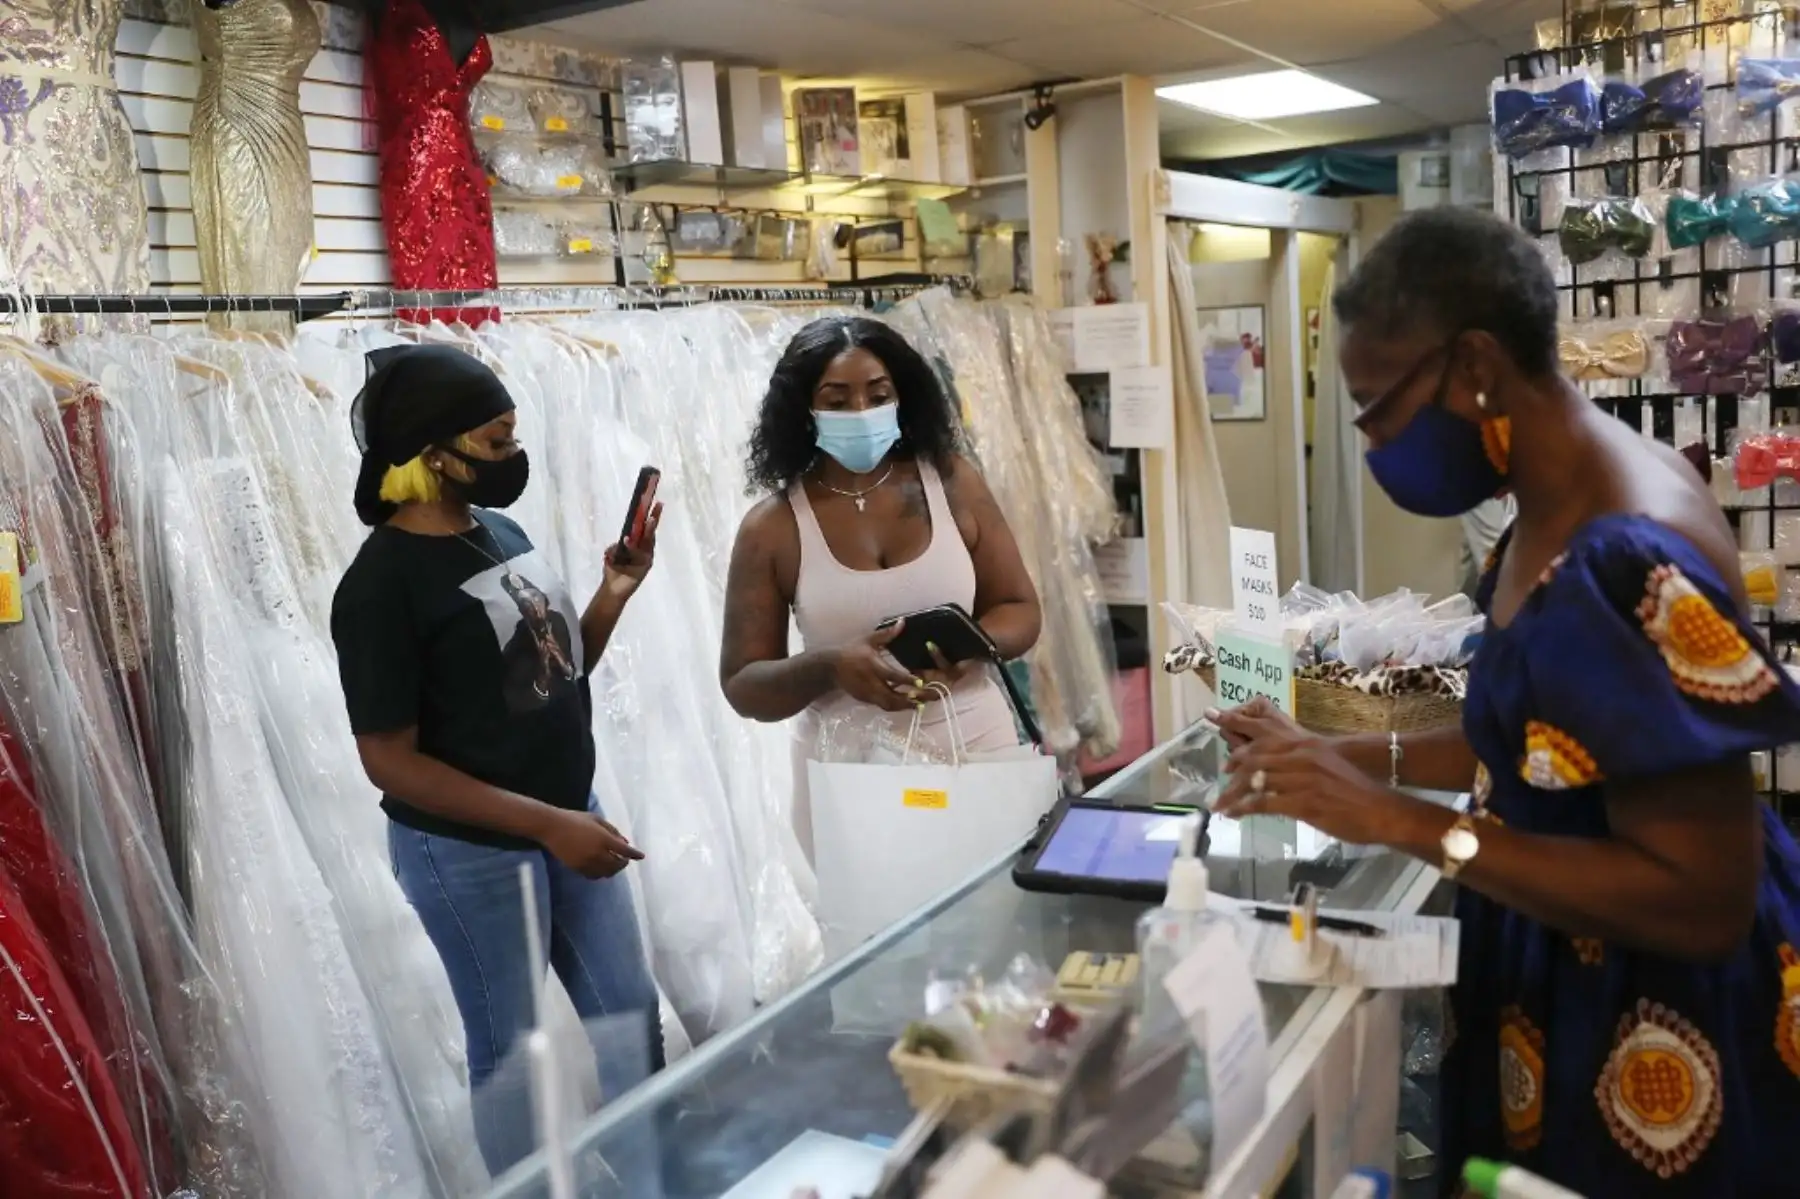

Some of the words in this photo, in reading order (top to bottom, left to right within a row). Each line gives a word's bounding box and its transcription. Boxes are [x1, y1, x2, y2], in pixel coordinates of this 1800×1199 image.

[1244, 552, 1268, 570] FACE
[1241, 576, 1273, 595] MASKS
[1217, 646, 1250, 673] Cash
[1254, 657, 1283, 684] App
